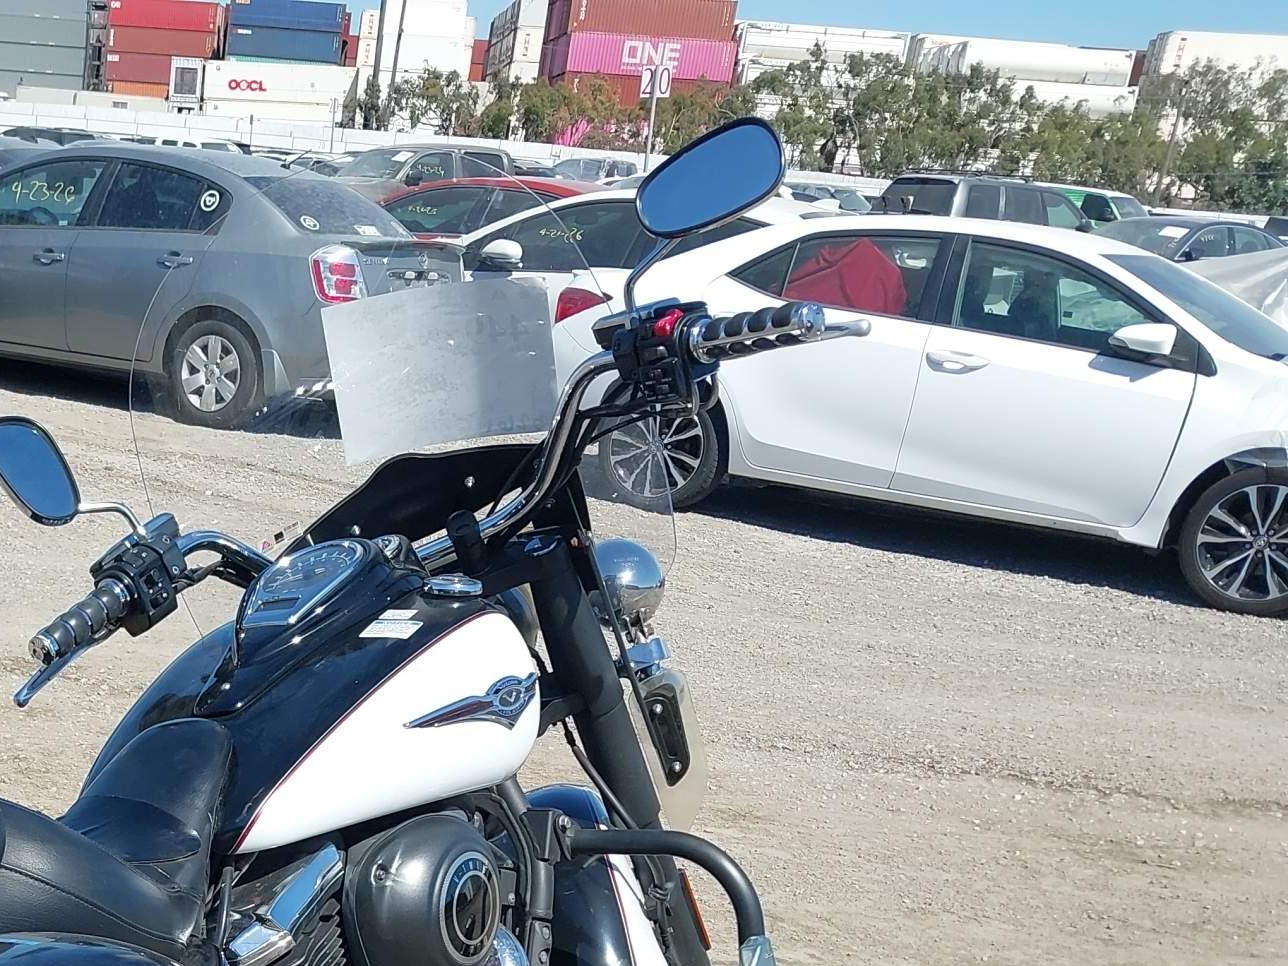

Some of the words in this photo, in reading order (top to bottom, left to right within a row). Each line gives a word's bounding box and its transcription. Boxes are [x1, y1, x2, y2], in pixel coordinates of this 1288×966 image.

[622, 40, 681, 66] ONE
[228, 79, 267, 92] OOCL
[642, 67, 671, 95] 20
